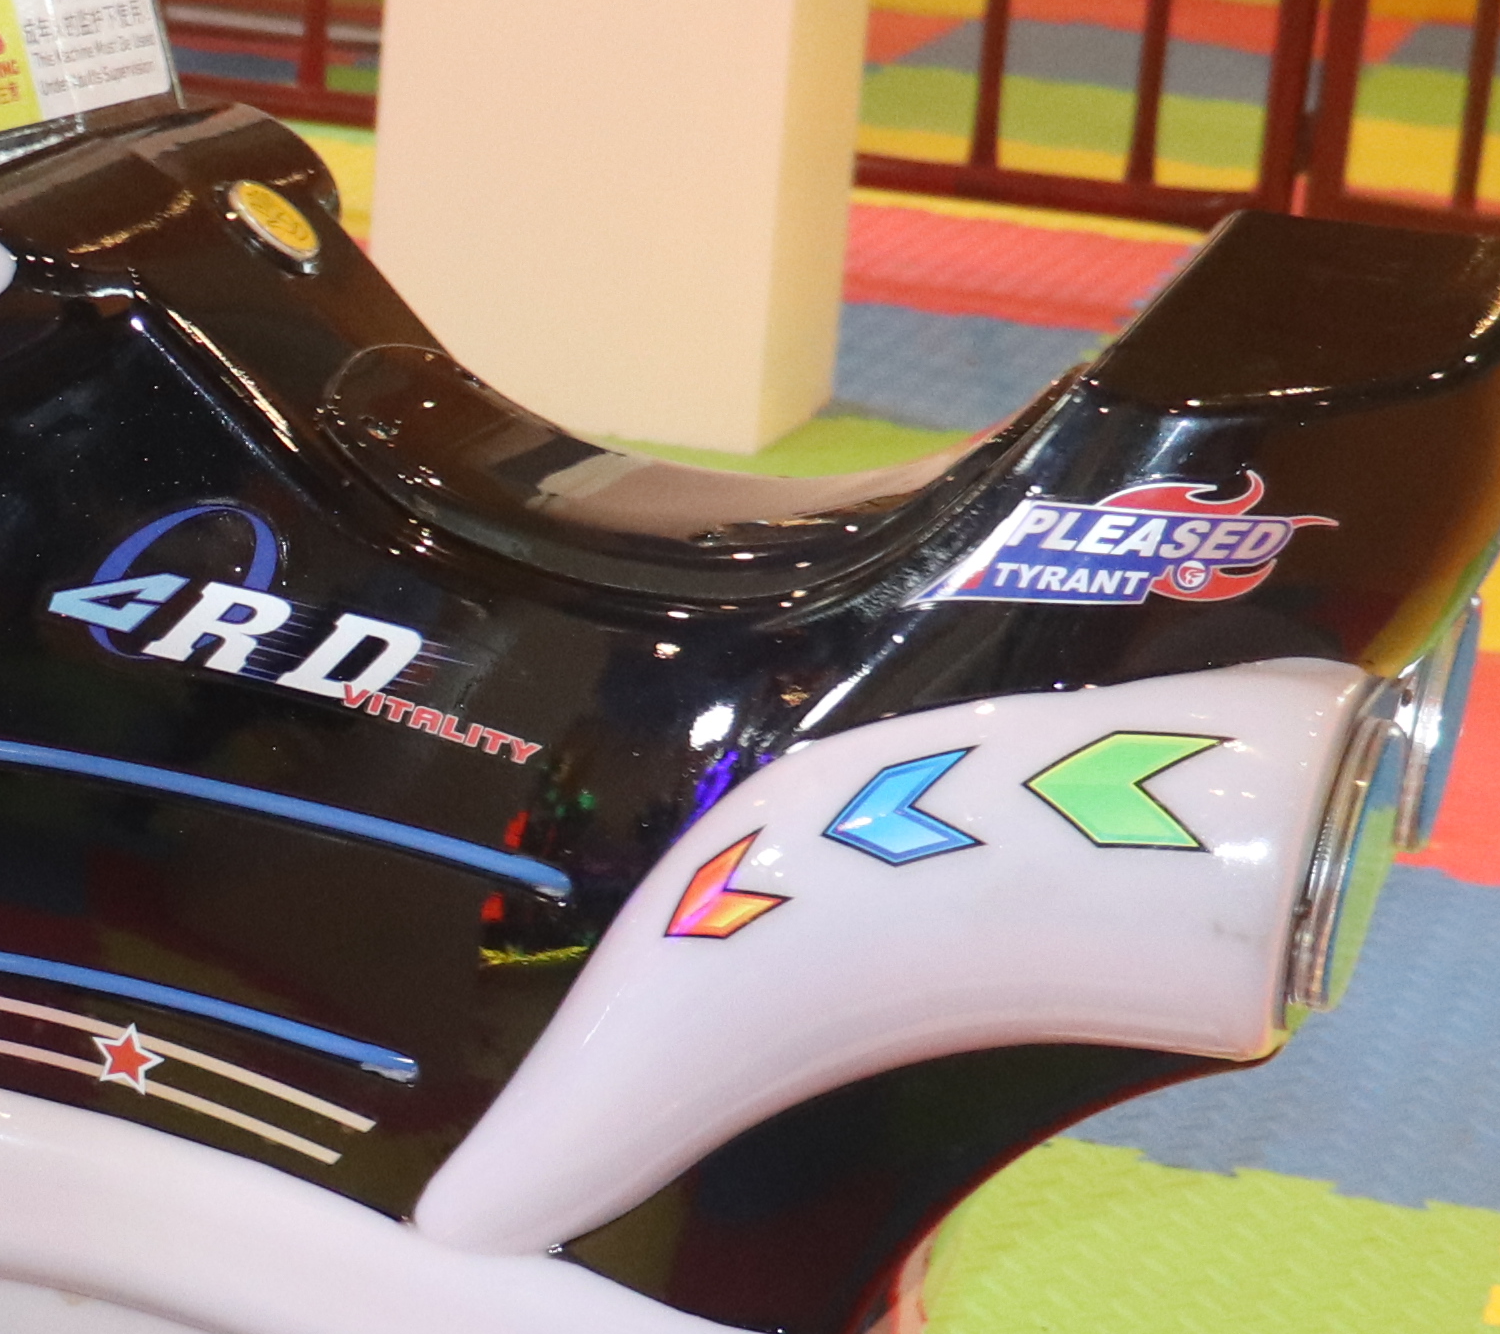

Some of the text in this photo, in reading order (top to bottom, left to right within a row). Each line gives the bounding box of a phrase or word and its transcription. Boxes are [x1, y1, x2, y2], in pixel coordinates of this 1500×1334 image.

[101, 58, 155, 83] Supervision
[1005, 507, 1293, 562] PLEASED
[994, 562, 1150, 596] TYRANT
[341, 683, 543, 765] VITALITY
